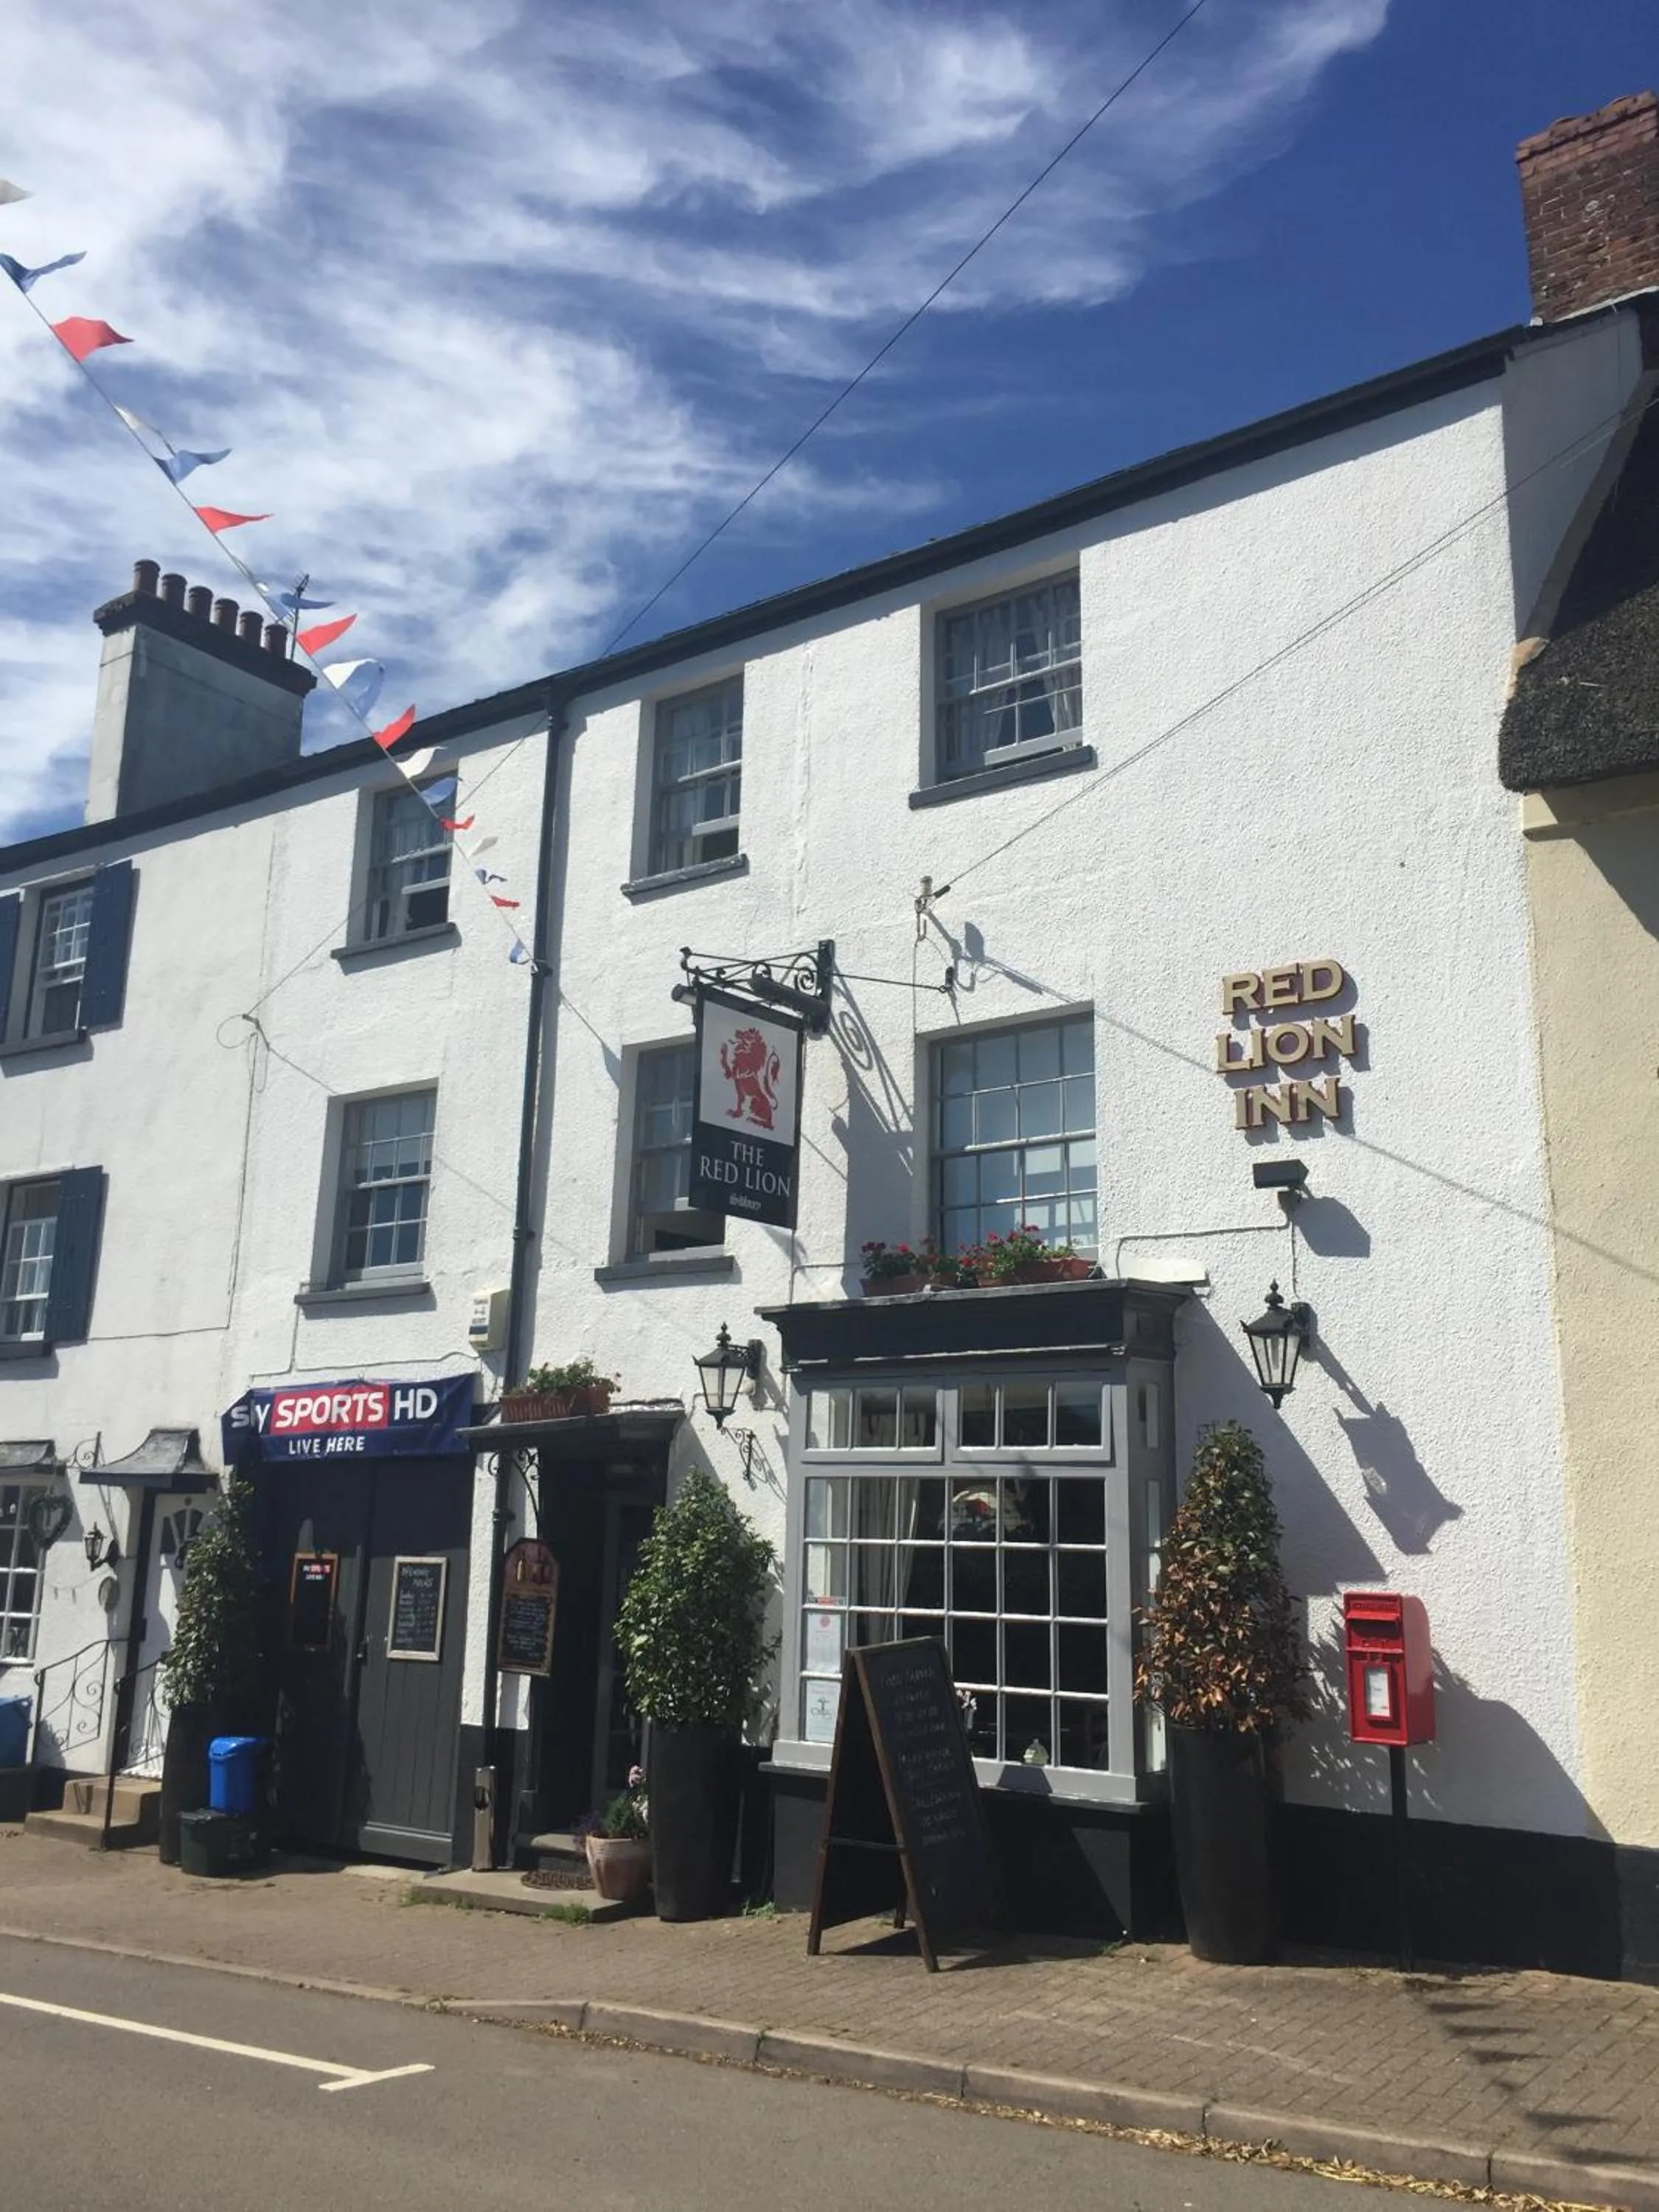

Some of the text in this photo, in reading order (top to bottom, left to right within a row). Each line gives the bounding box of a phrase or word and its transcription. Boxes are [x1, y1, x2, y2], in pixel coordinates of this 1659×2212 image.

[1222, 959, 1343, 1015] RED
[1216, 1014, 1356, 1074] LION
[1234, 1077, 1340, 1130] INN
[731, 1141, 765, 1167] THE
[700, 1155, 791, 1198] RED LION
[275, 1391, 385, 1428] SPORTS
[393, 1388, 438, 1421] HD
[288, 1436, 366, 1455] LIVE HERE
